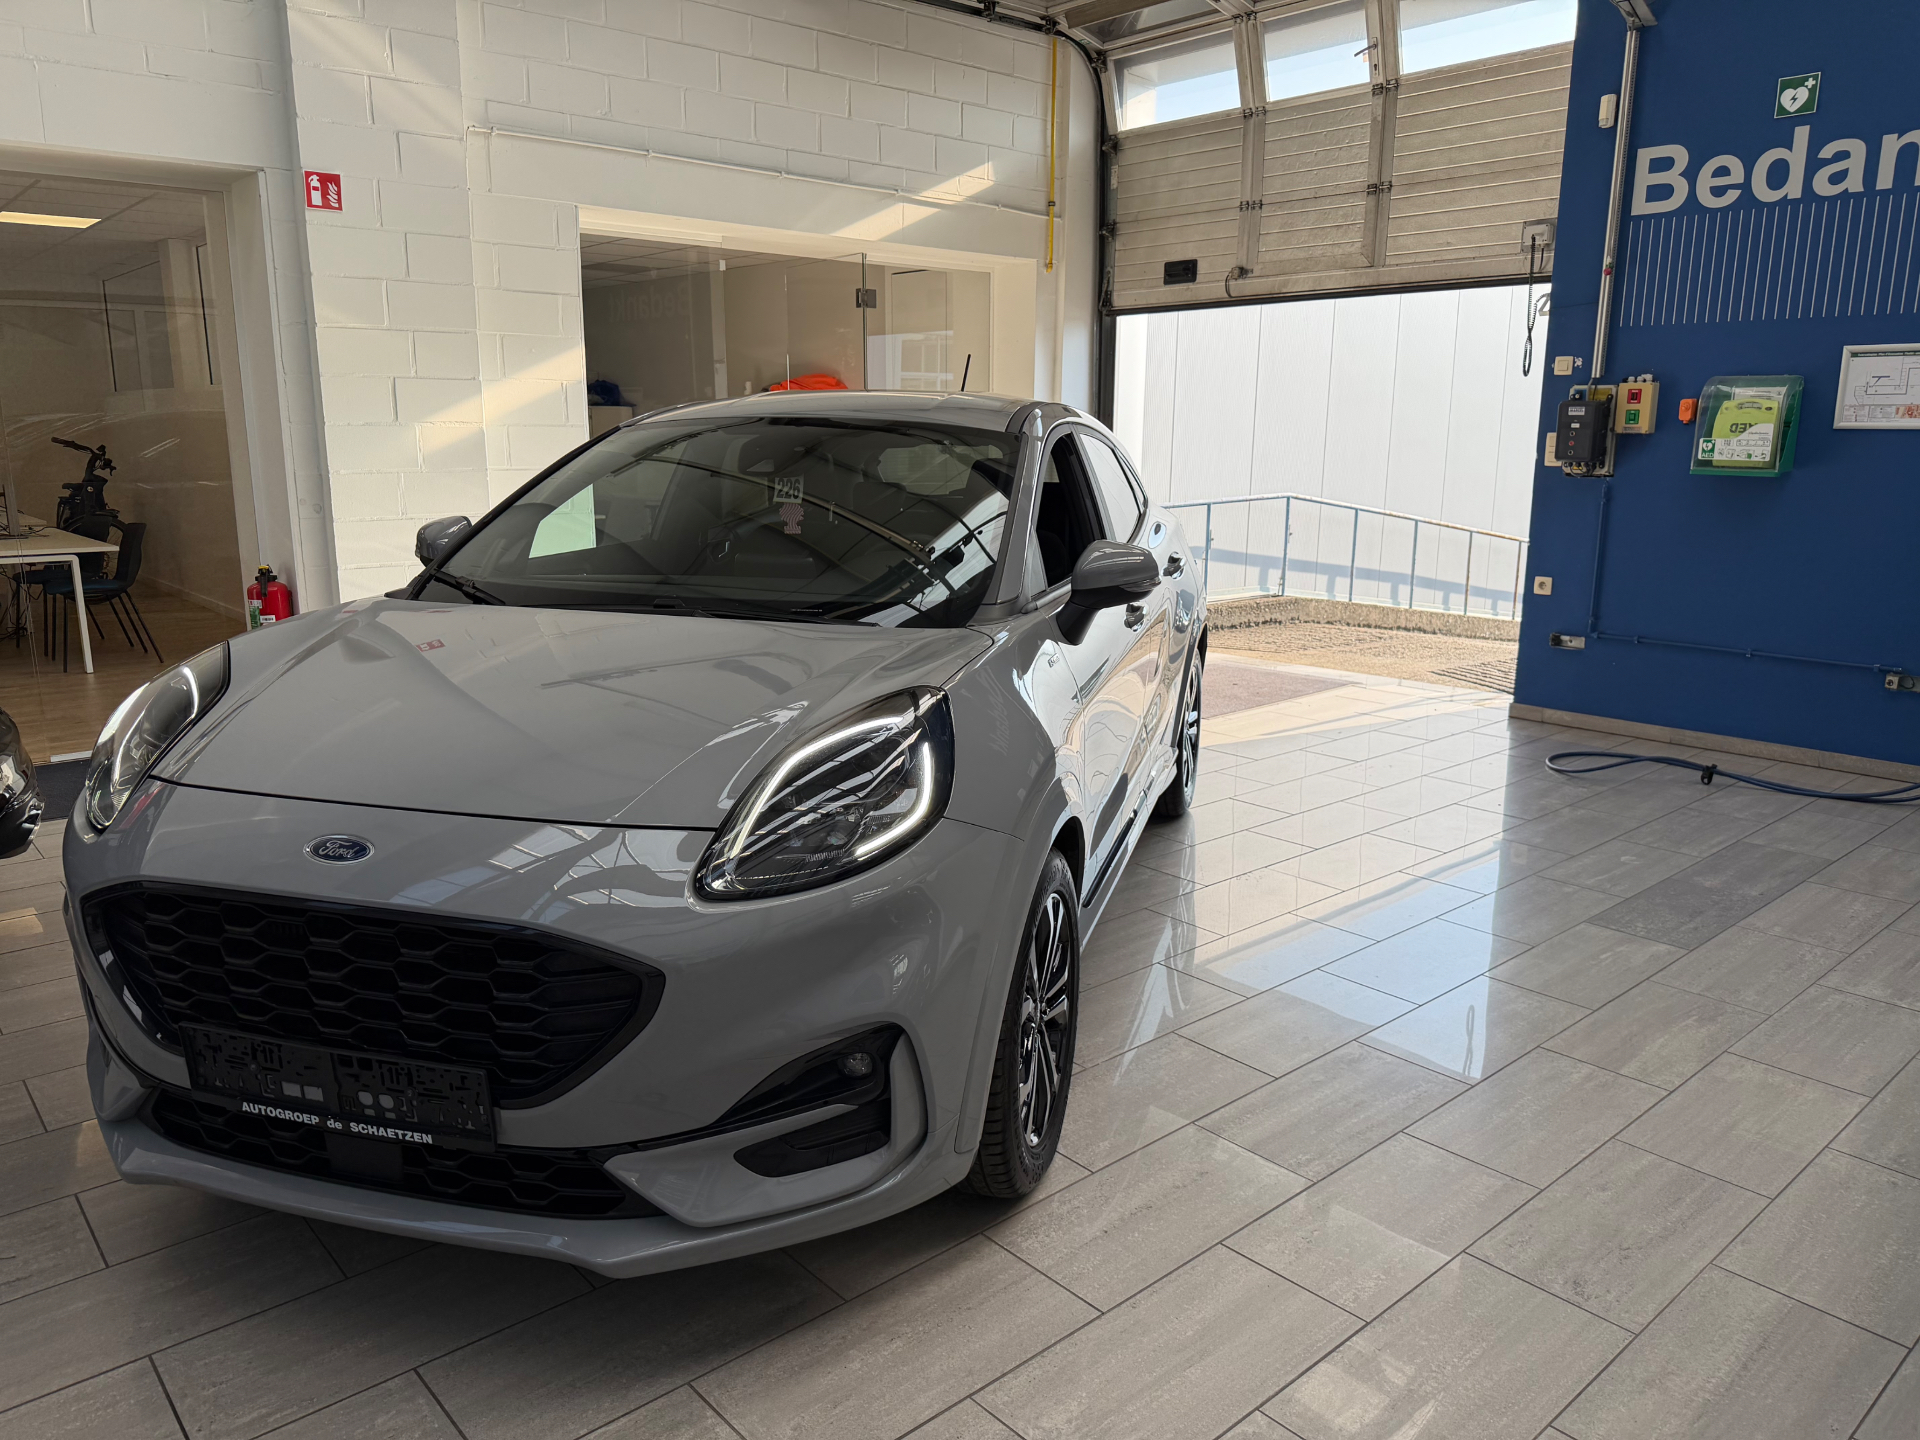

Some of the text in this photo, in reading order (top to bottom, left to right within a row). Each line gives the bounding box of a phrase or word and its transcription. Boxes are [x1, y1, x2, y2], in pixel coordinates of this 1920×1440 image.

[1631, 125, 1920, 216] Bedan
[776, 478, 801, 499] 226
[319, 840, 360, 858] Ford
[242, 1102, 433, 1144] AUTOGROEP de SCHAETZEN
